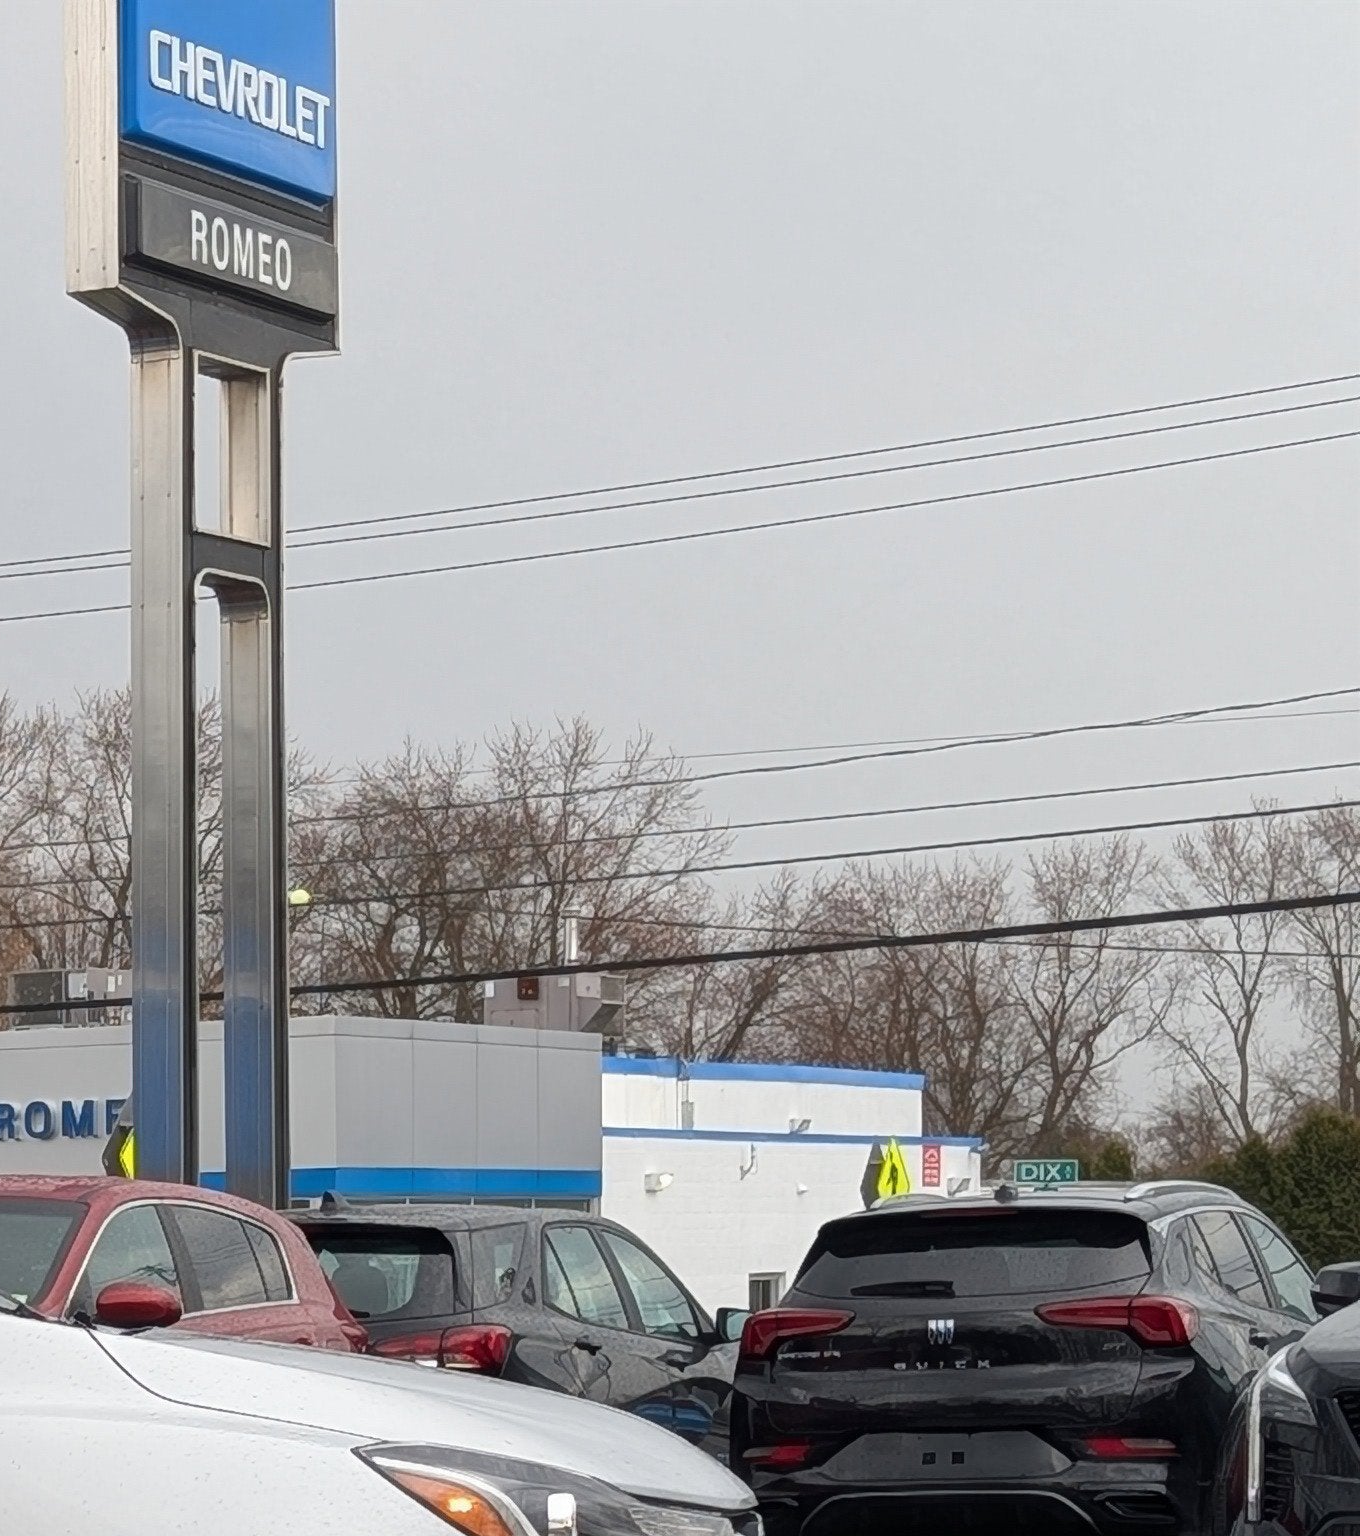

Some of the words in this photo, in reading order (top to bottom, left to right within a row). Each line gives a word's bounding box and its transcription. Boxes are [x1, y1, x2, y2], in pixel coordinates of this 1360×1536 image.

[149, 29, 330, 149] CHEVROLET
[190, 209, 292, 291] ROMEO
[1020, 1163, 1061, 1180] DIX
